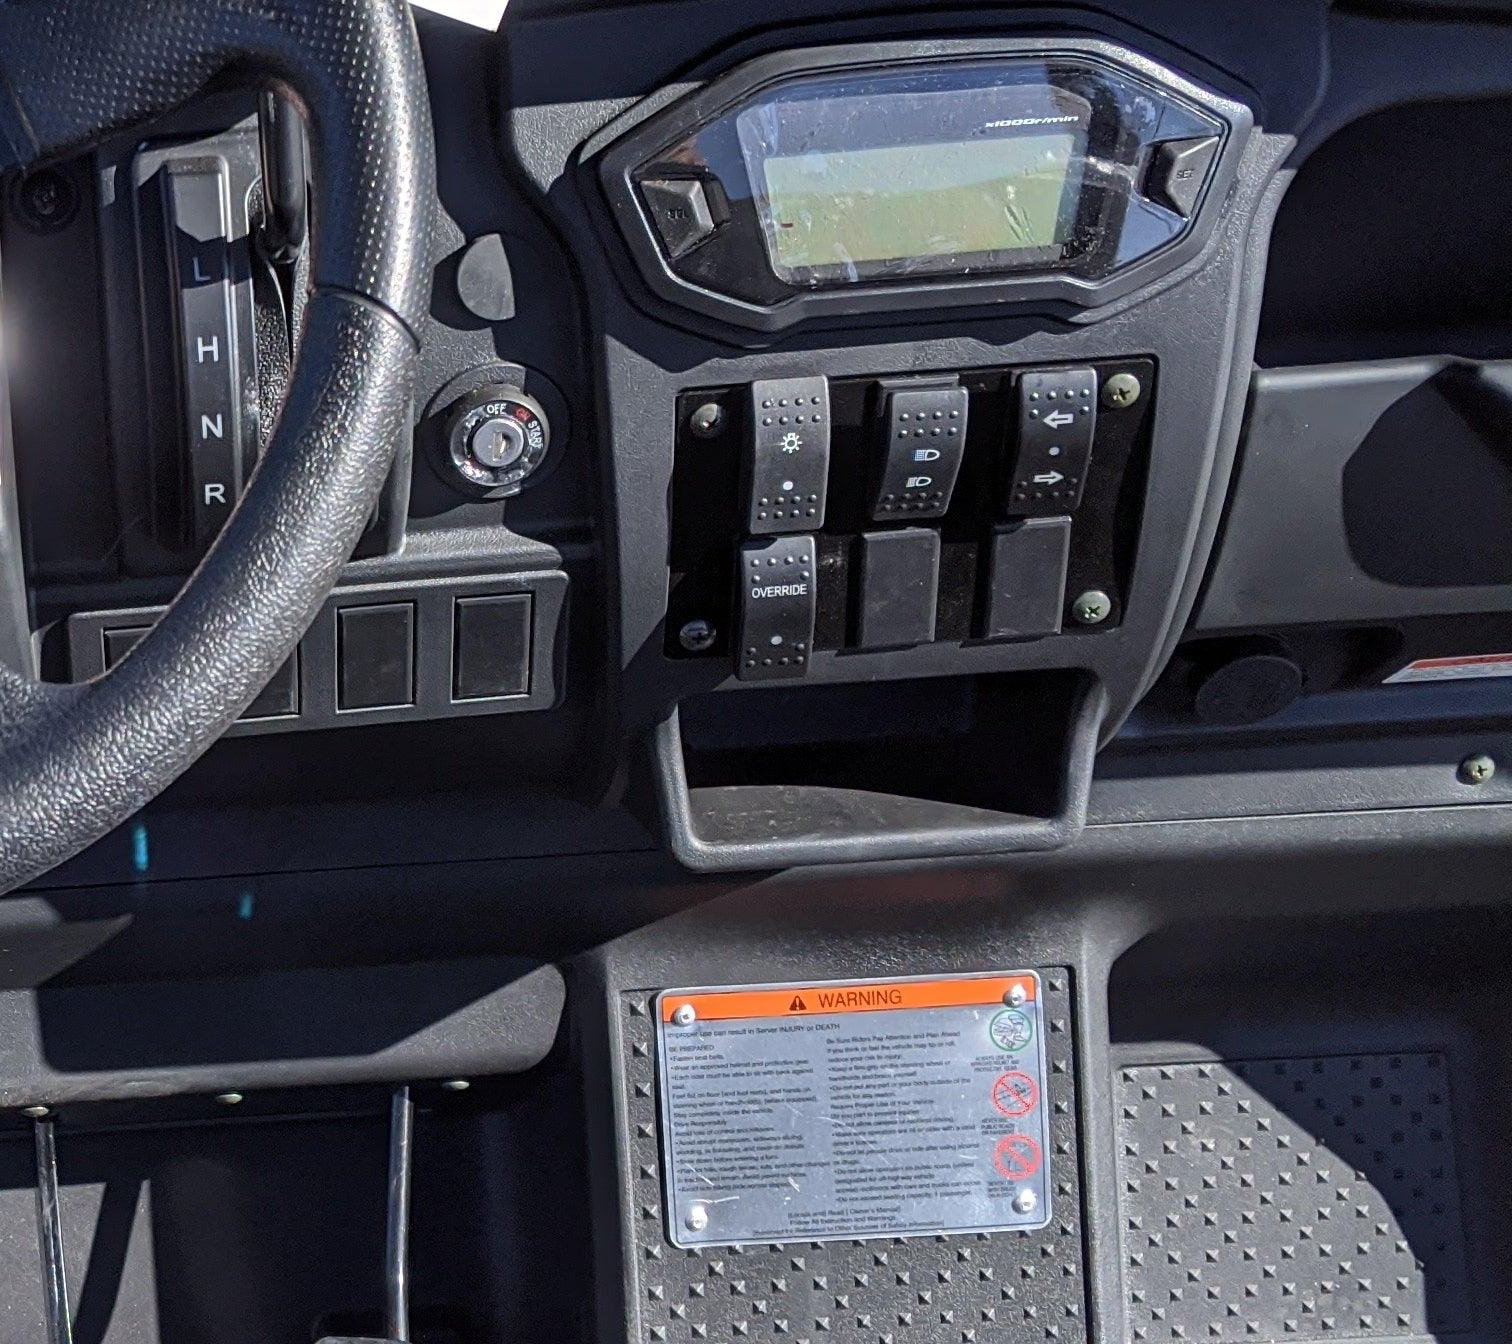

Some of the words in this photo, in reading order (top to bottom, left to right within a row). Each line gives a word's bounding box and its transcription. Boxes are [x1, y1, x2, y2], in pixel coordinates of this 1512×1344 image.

[985, 115, 1080, 128] x1000r/min
[193, 257, 211, 282] L
[197, 337, 219, 363] H
[486, 403, 507, 415] OFF
[201, 414, 223, 439] N
[528, 420, 544, 449] START
[205, 484, 226, 505] R
[751, 584, 808, 599] OVERRIDE
[818, 989, 903, 1008] WARNING
[816, 1023, 840, 1031] DEATH
